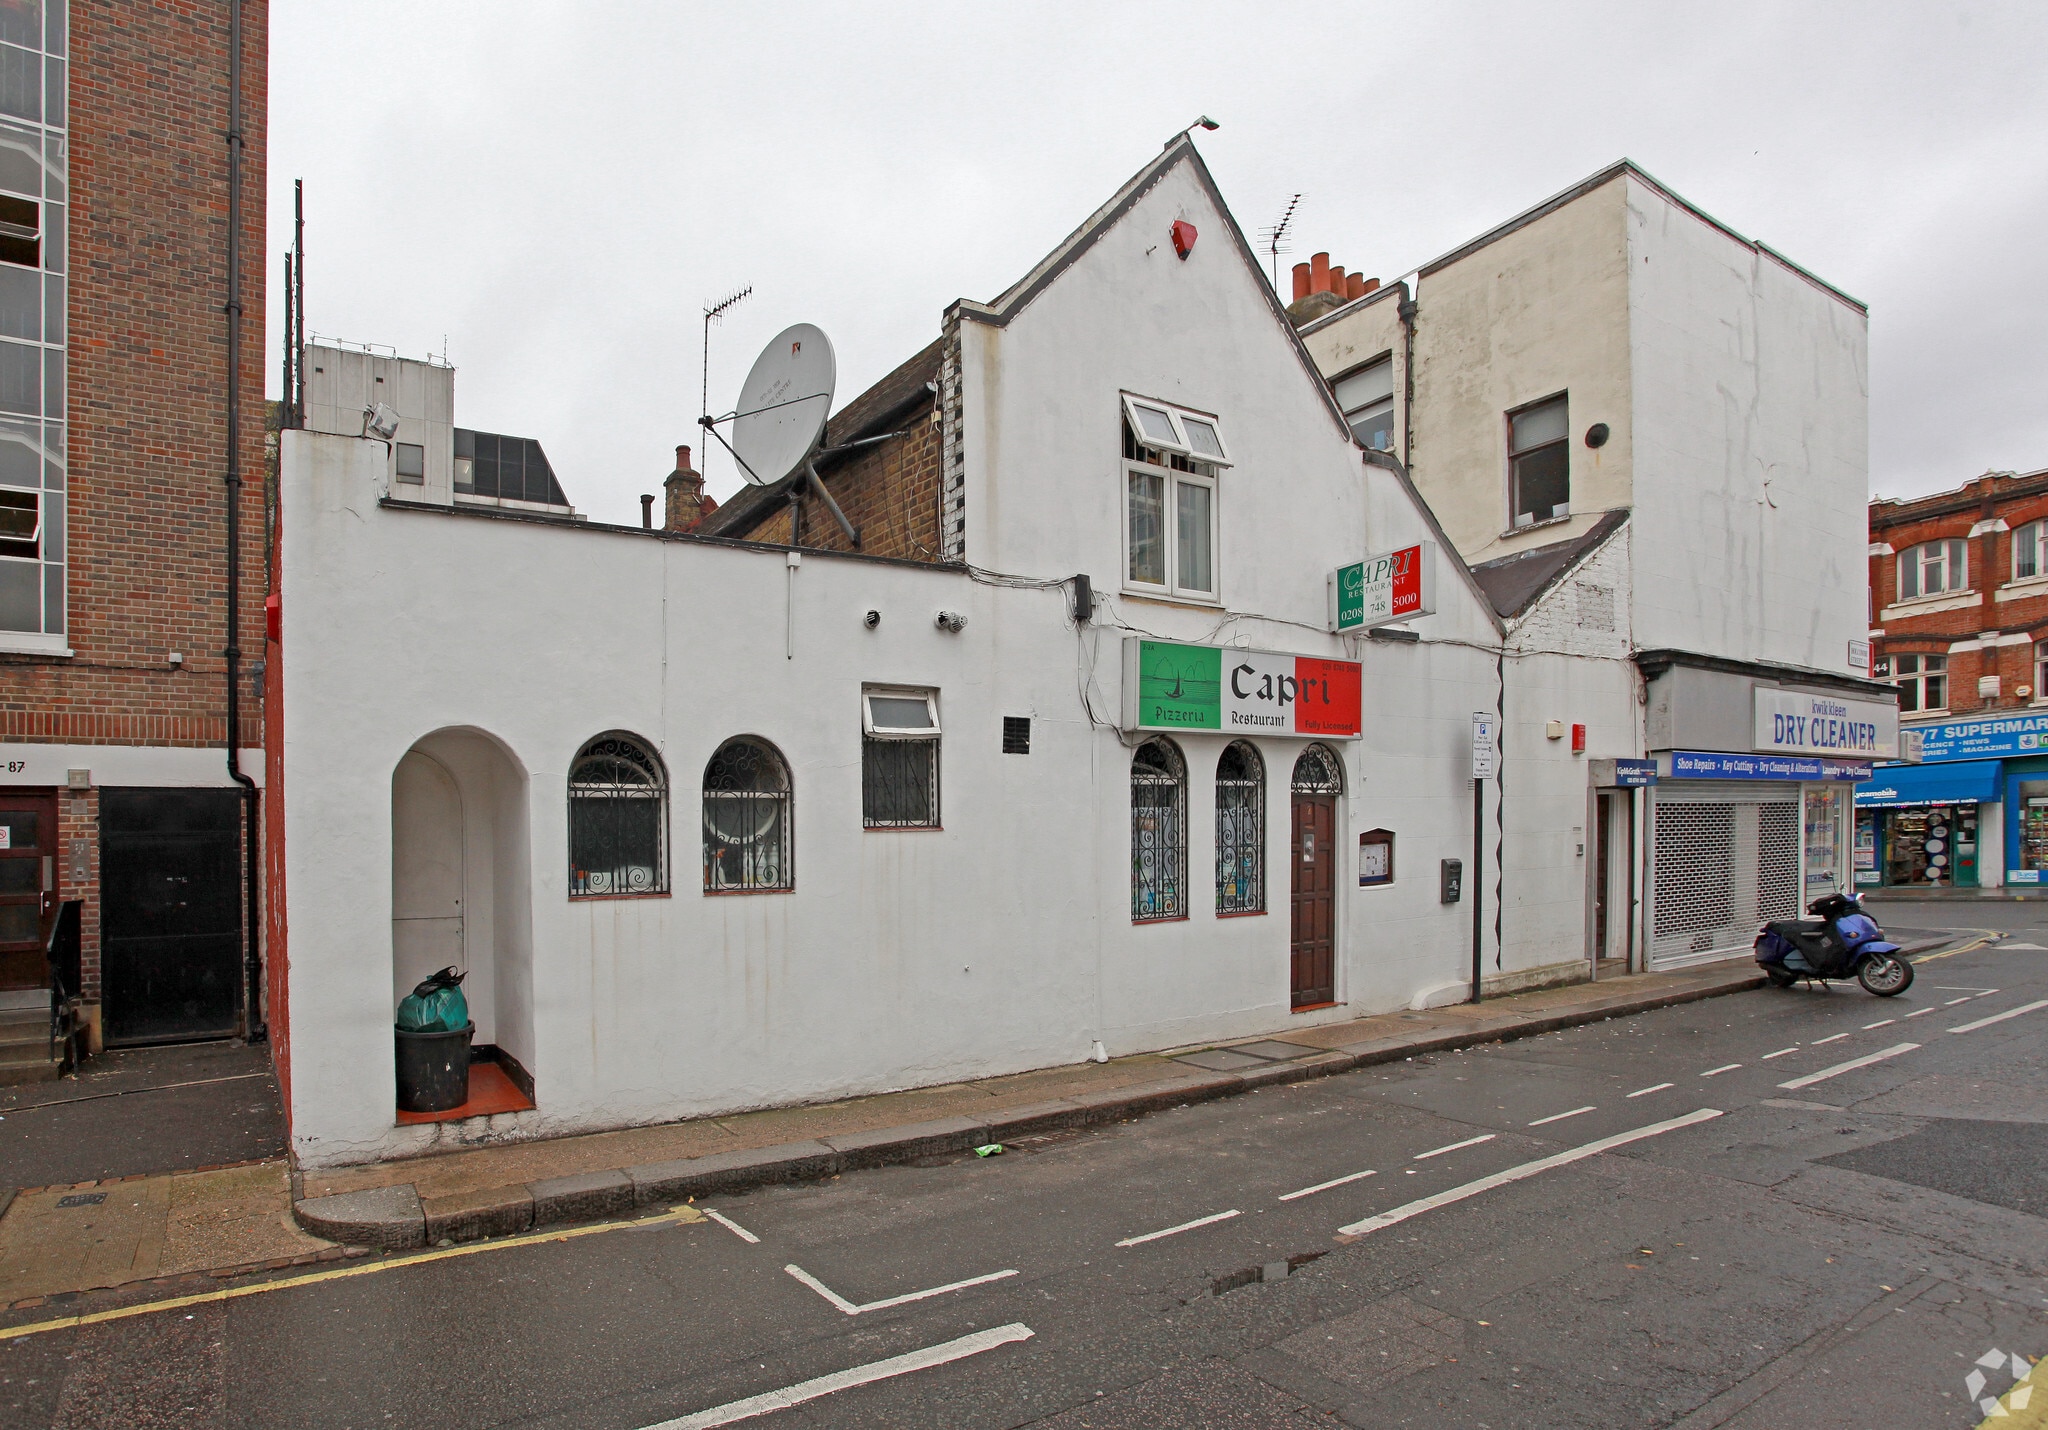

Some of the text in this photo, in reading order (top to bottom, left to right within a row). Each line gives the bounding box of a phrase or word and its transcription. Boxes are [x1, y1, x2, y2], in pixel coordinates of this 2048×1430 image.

[1344, 551, 1412, 590] CAPRI
[1348, 577, 1405, 598] RESTAURANT
[1341, 592, 1417, 622] 0208 748 5000
[1231, 664, 1330, 706] Capri
[1155, 706, 1205, 722] Pizzeria
[1812, 699, 1847, 717] kwik kleen
[1231, 711, 1285, 727] Restaurant
[1305, 720, 1353, 731] Fully Licensed
[1774, 713, 1876, 750] DRY CLEANER
[1922, 738, 1990, 749] ICENCE NEWS
[1963, 744, 2012, 753] MAGAZINE
[8, 761, 25, 773] 87
[1677, 757, 1872, 777] Shoe Repairs Key Cutting Dry Cleaning & Alteration Laundry Dry Cleaning
[1854, 787, 1897, 798] ycamobile
